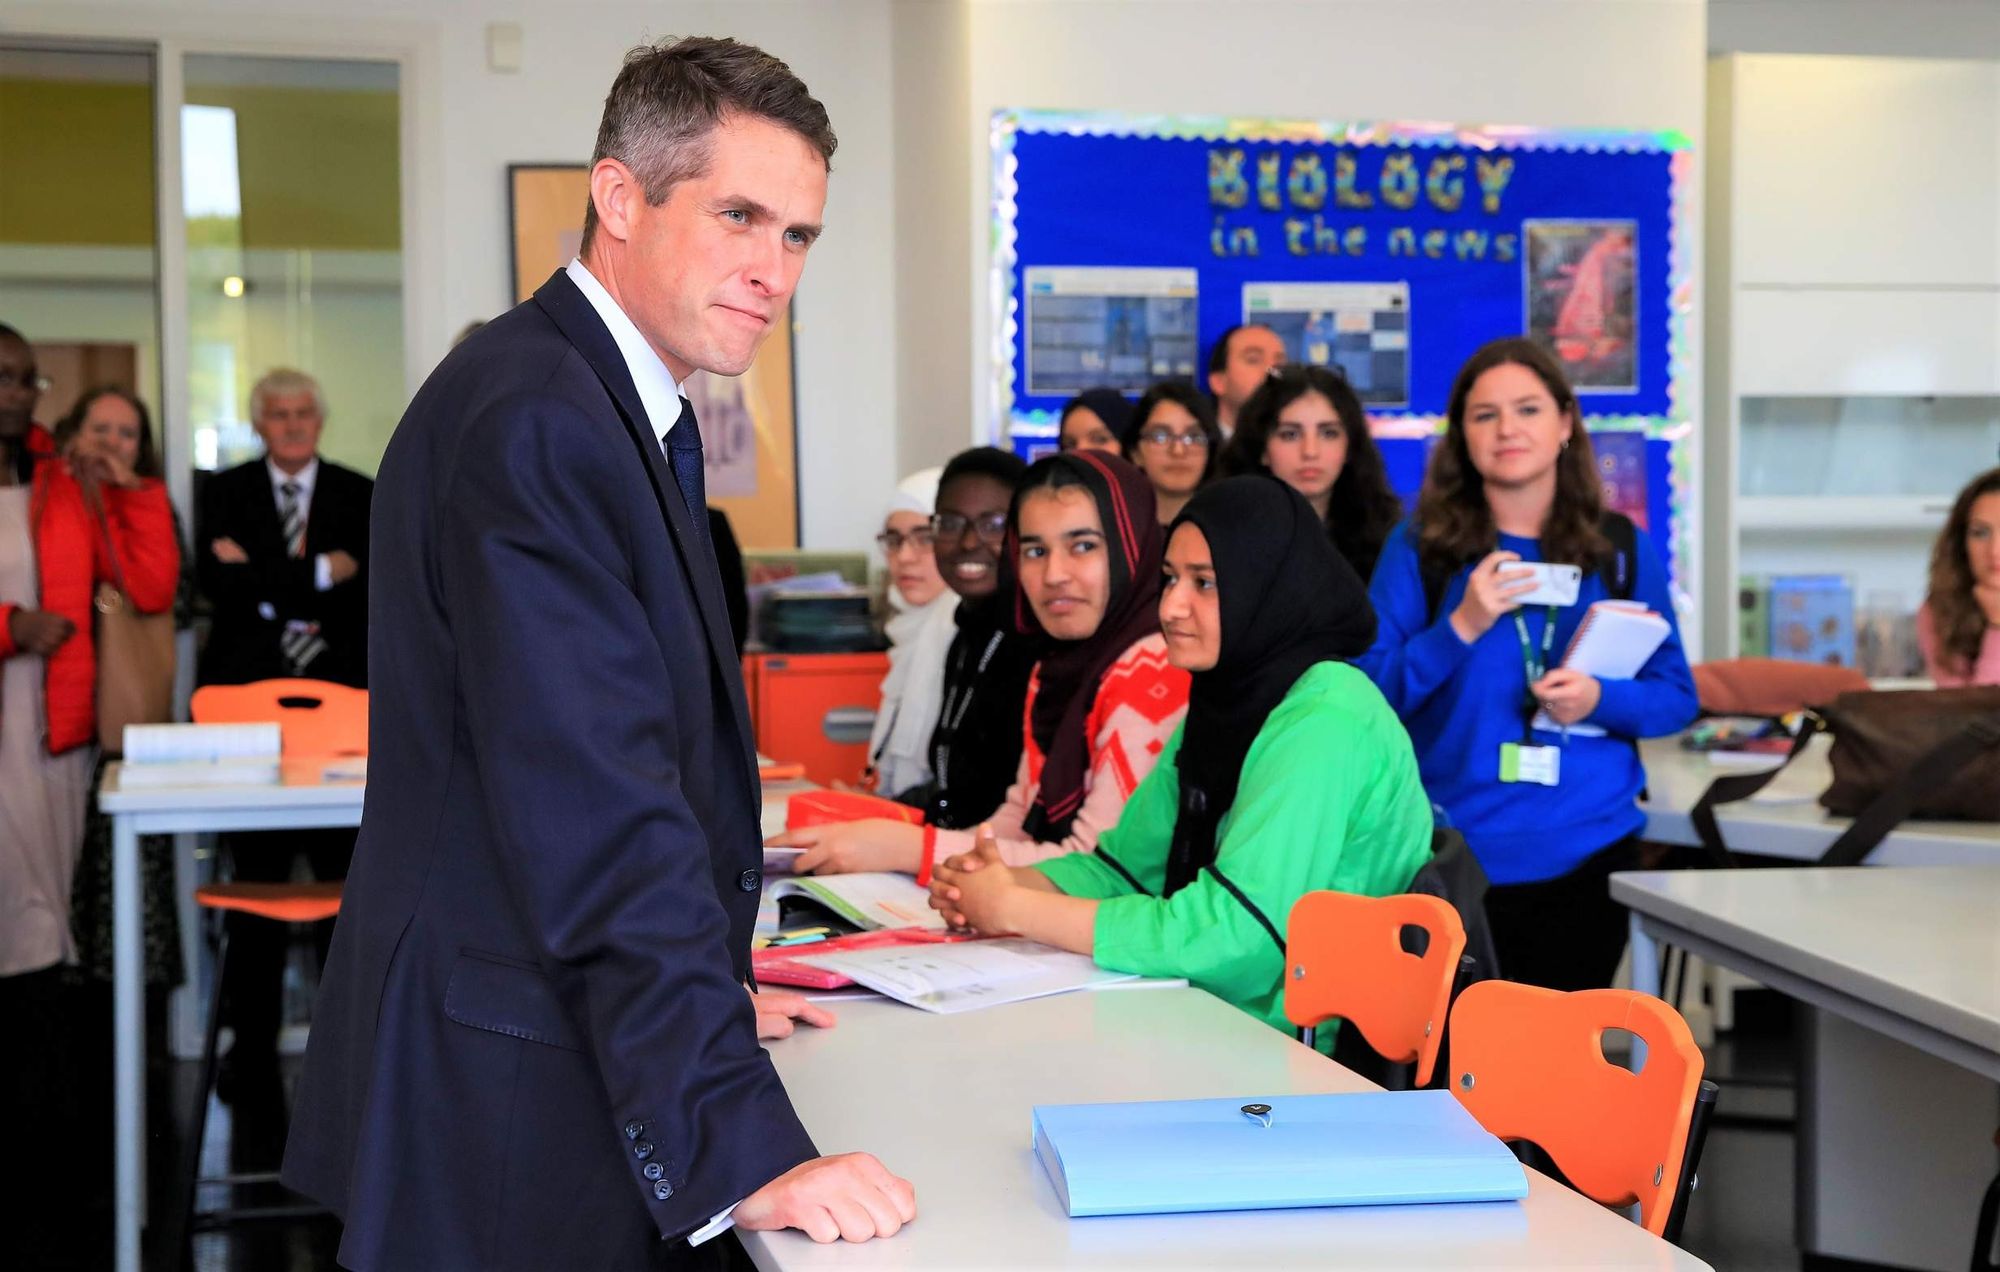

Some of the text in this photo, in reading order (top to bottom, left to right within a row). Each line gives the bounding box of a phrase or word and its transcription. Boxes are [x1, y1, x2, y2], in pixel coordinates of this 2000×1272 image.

[1208, 149, 1514, 213] BIOLOGY
[1210, 213, 1517, 261] in the news
